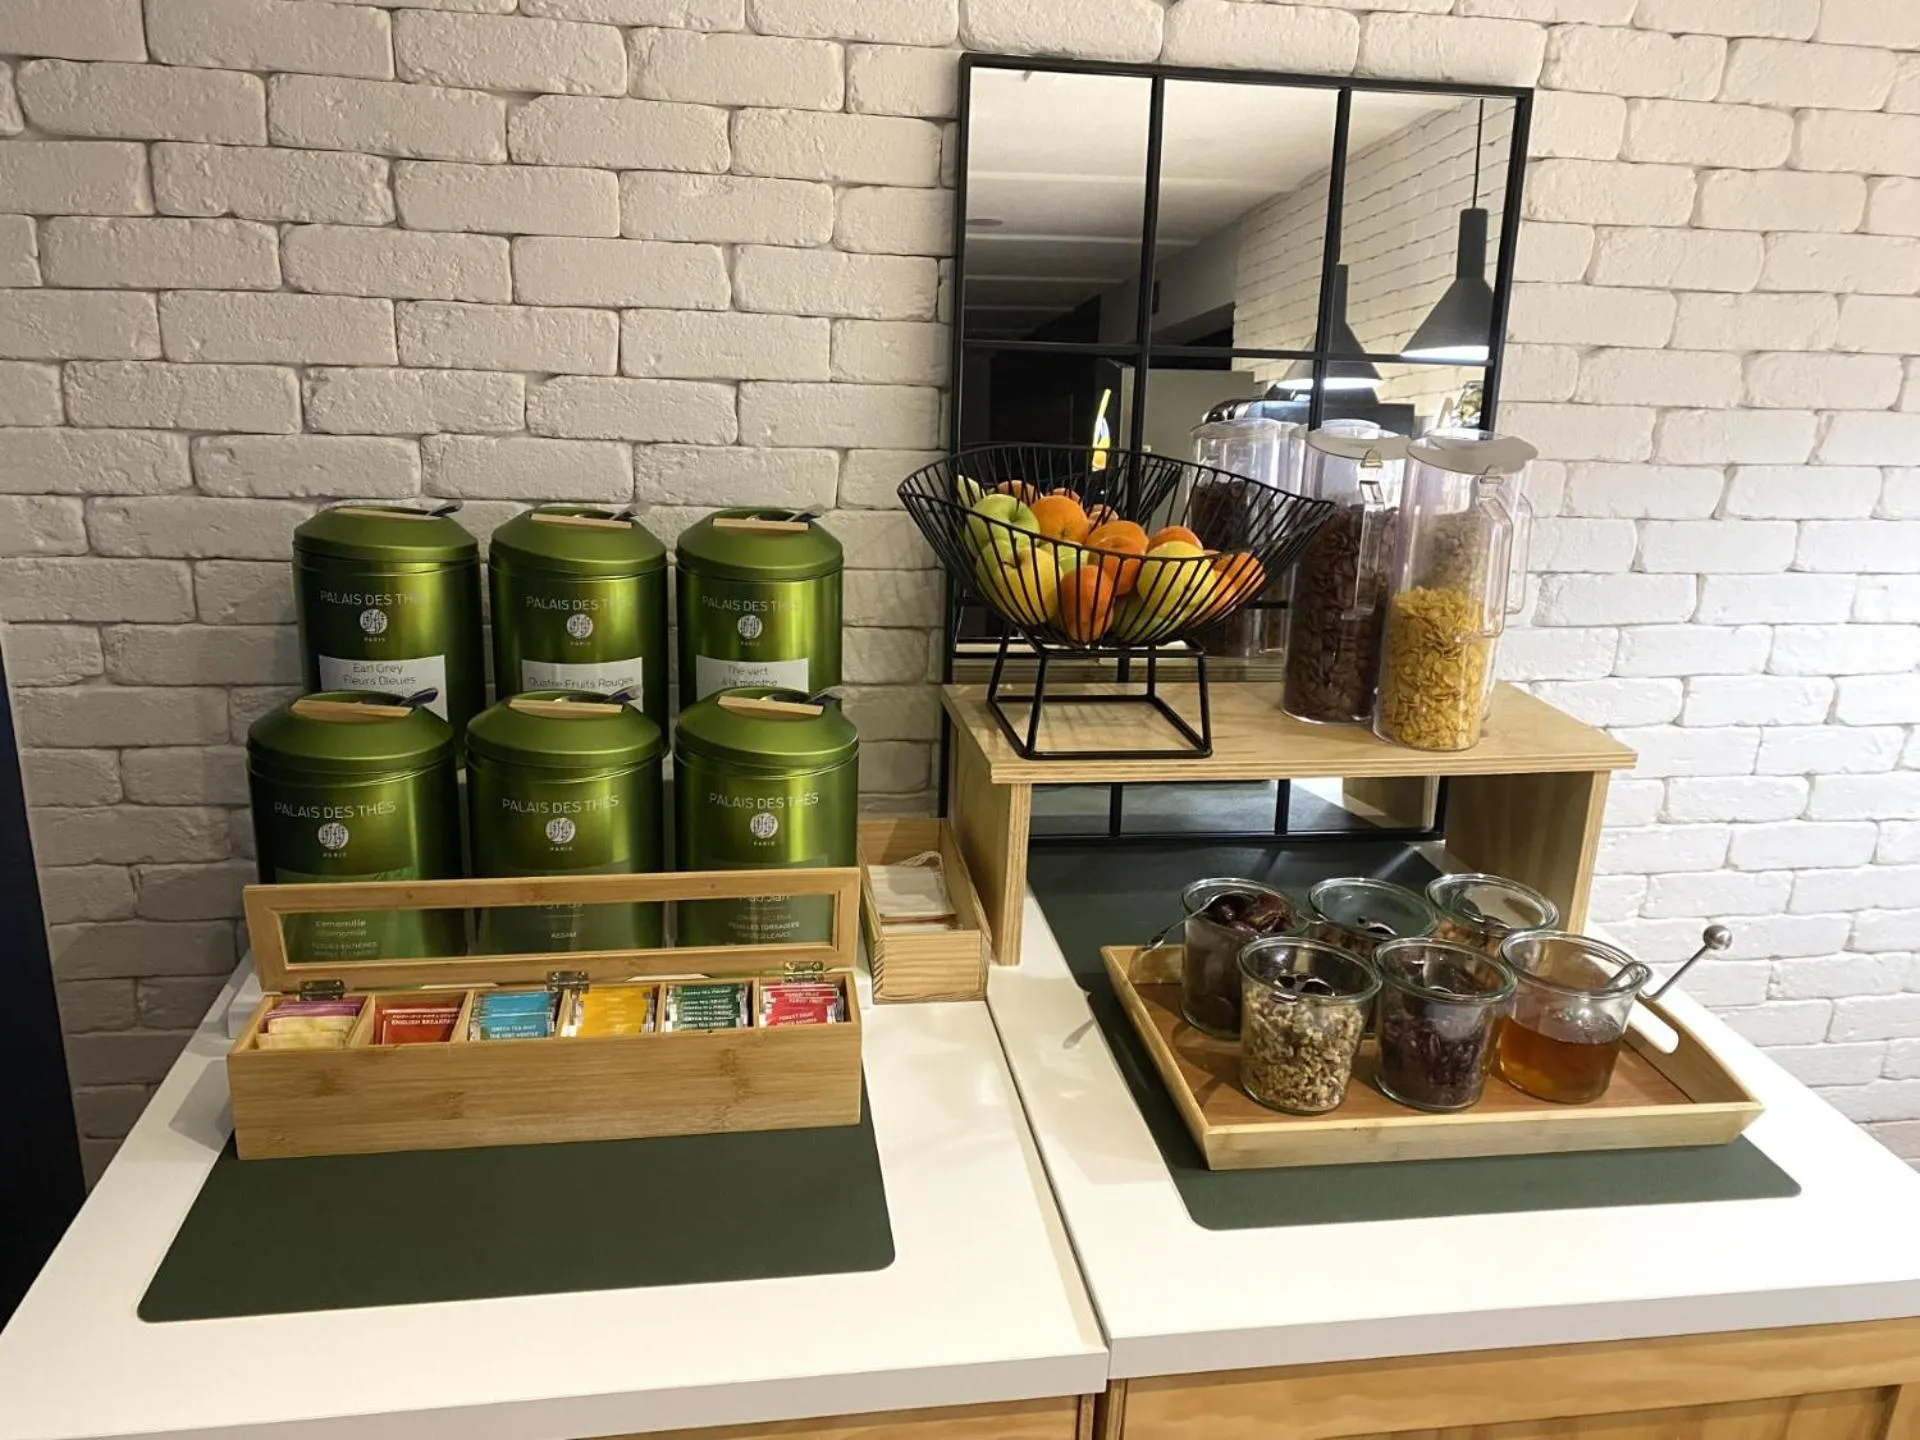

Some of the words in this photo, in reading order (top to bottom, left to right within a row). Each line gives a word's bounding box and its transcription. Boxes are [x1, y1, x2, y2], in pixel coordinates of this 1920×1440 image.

[320, 590, 362, 605] PALAIS
[365, 593, 393, 606] DES
[526, 596, 569, 610] PALAIS
[572, 599, 599, 611] DES
[702, 595, 741, 611] PALAIS
[743, 600, 768, 612] DES
[352, 663, 375, 673] Earl
[376, 663, 404, 675] Grey
[746, 666, 768, 676] vert
[342, 676, 377, 686] Fleurs
[565, 679, 597, 689] Fruits
[598, 677, 634, 689] Rouges
[502, 798, 549, 814] PALAIS
[552, 801, 582, 814] DES
[709, 792, 754, 809] PALAIS
[757, 796, 785, 809] DES
[274, 801, 321, 819] PALAIS
[323, 806, 355, 819] DES
